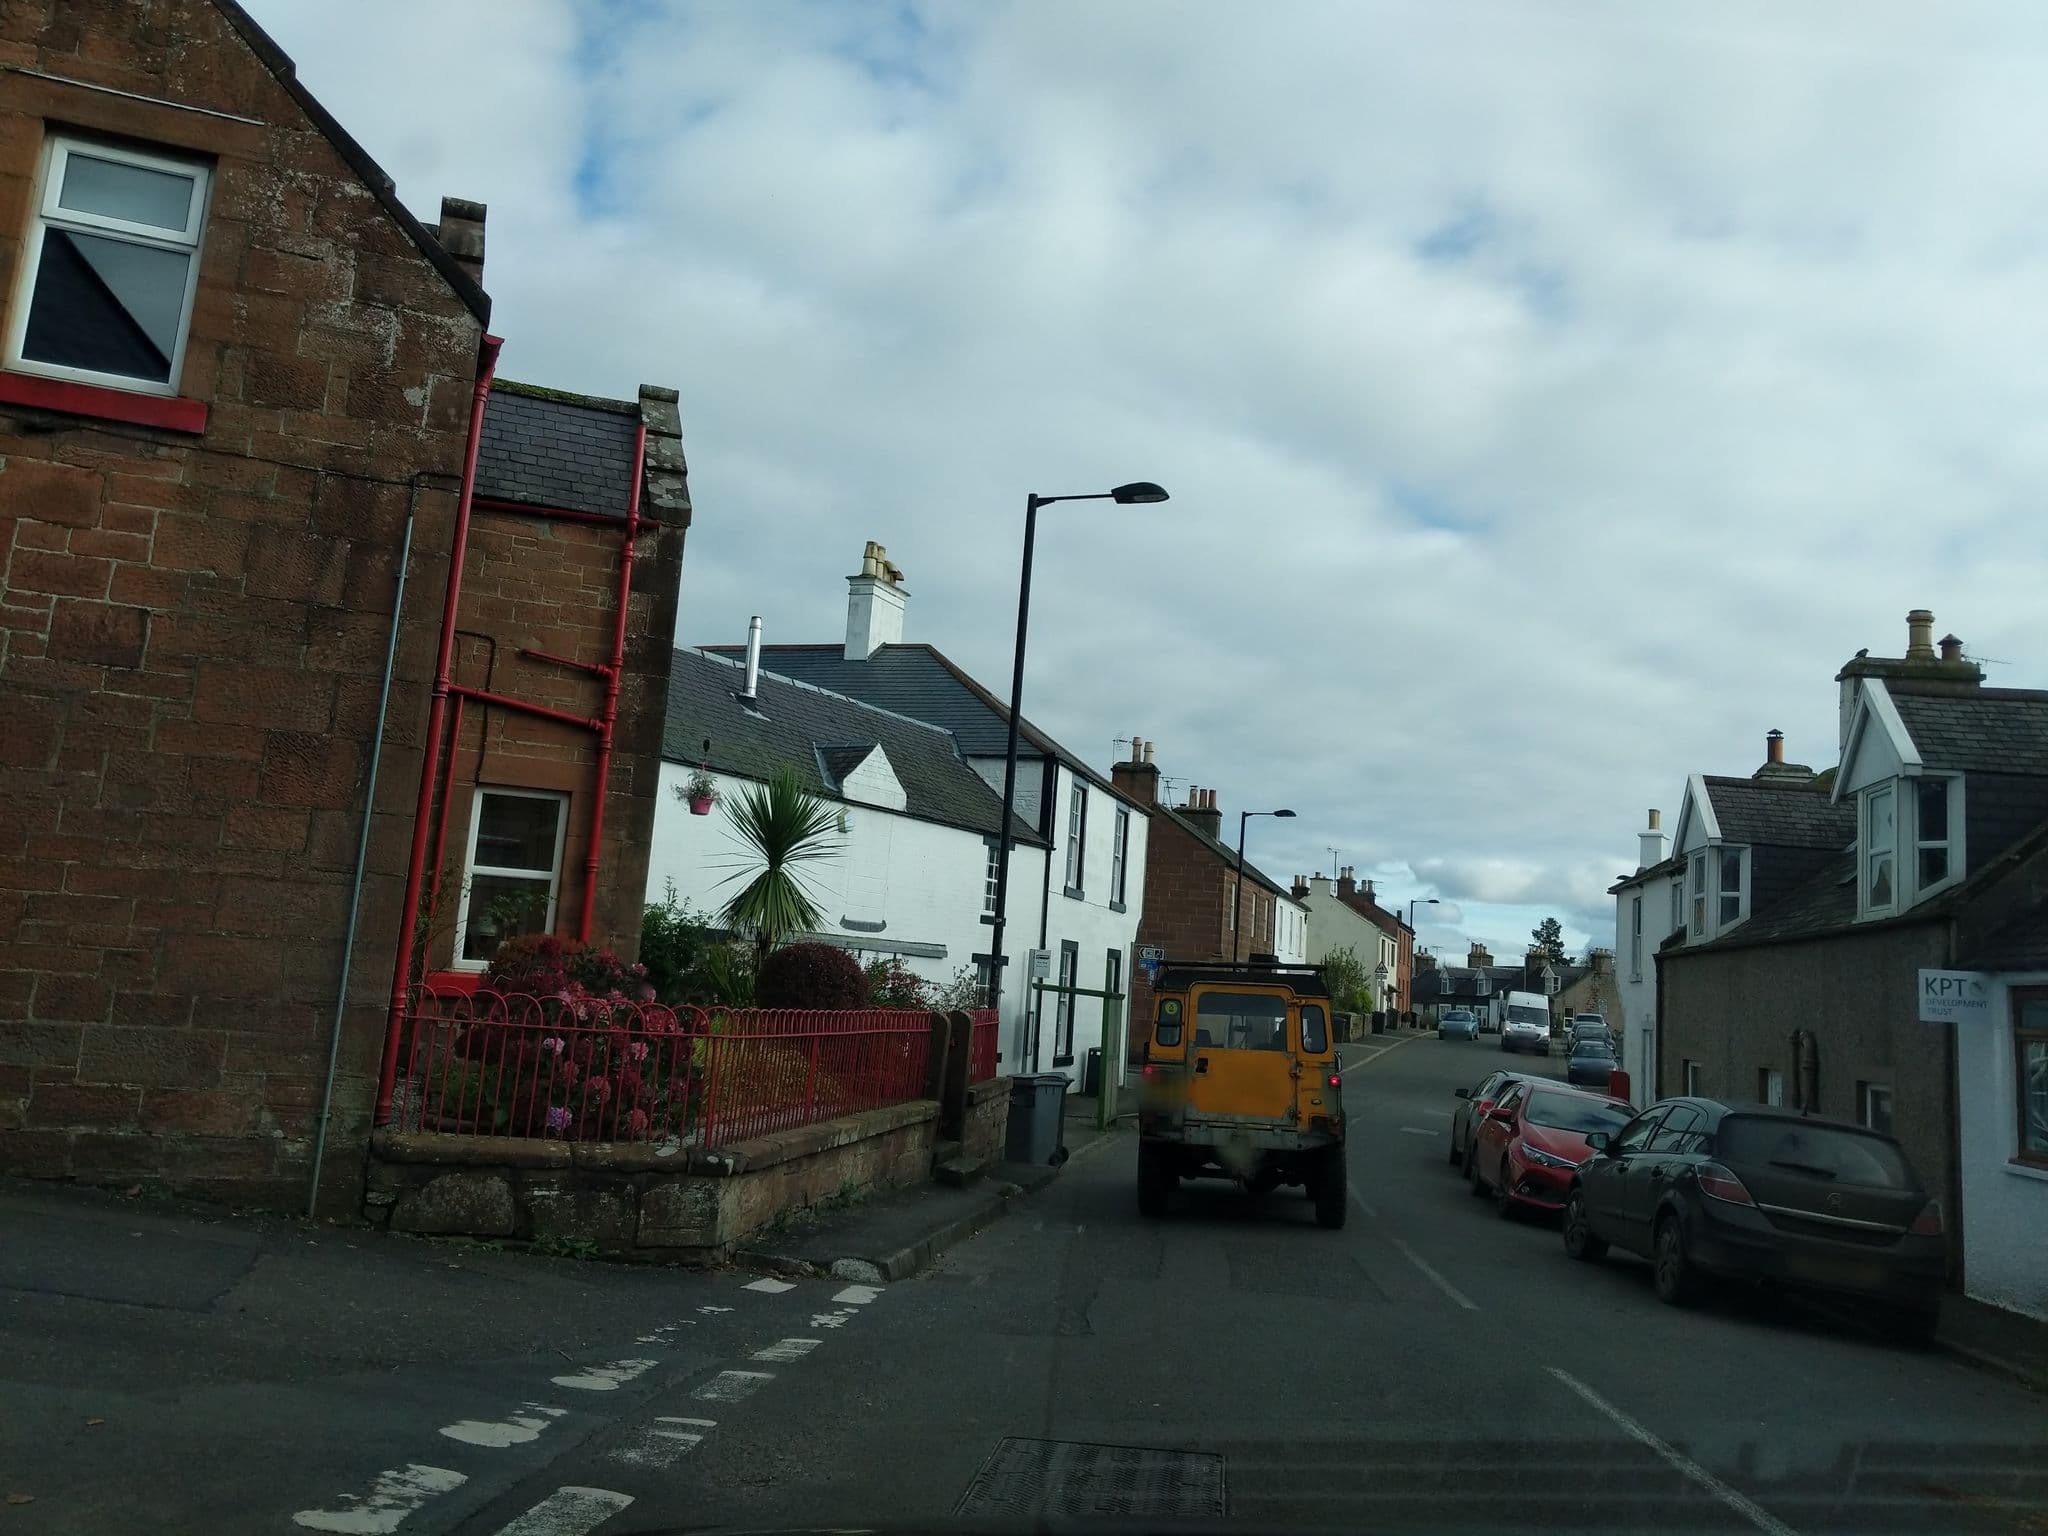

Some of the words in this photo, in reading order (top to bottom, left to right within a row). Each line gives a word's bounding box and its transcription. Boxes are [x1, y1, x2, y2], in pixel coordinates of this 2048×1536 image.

[1925, 977, 1967, 997] KPT
[1926, 998, 1989, 1009] DEVELOPMENT
[1927, 1007, 1953, 1016] TRUST
